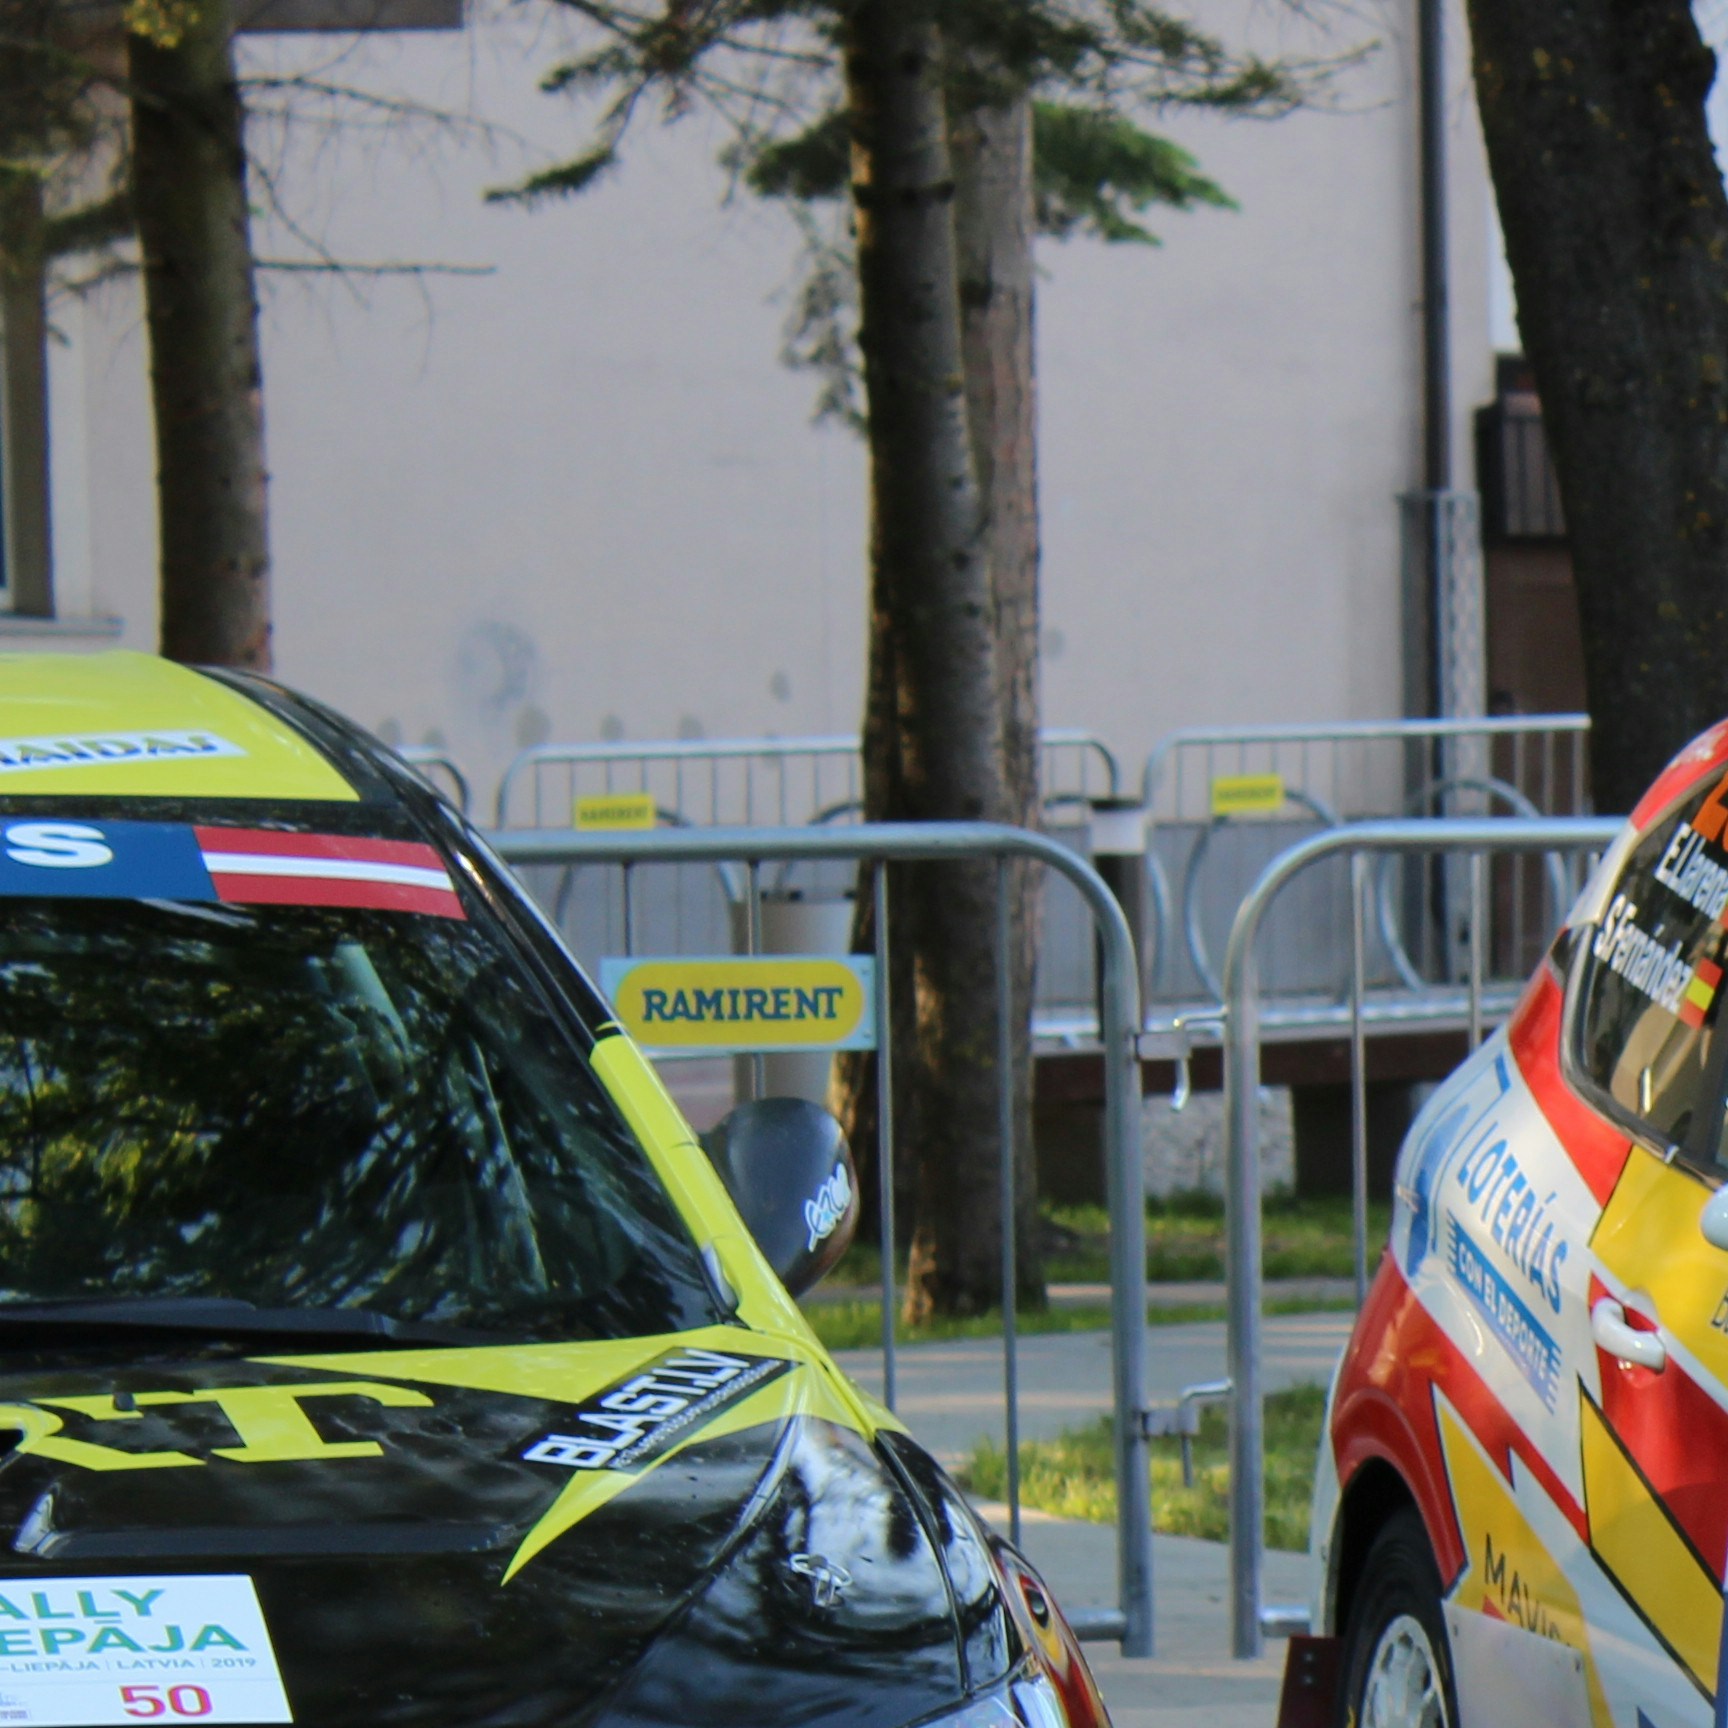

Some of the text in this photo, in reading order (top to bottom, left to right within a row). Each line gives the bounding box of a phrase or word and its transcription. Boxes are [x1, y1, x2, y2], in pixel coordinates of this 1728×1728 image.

[641, 986, 844, 1022] RAMIRENT
[1458, 1121, 1567, 1315] LOTERÍAS
[523, 1348, 751, 1468] BLAST.LV
[117, 1658, 195, 1671] LATVIA
[211, 1657, 257, 1669] 2019
[119, 1684, 213, 1718] 50
